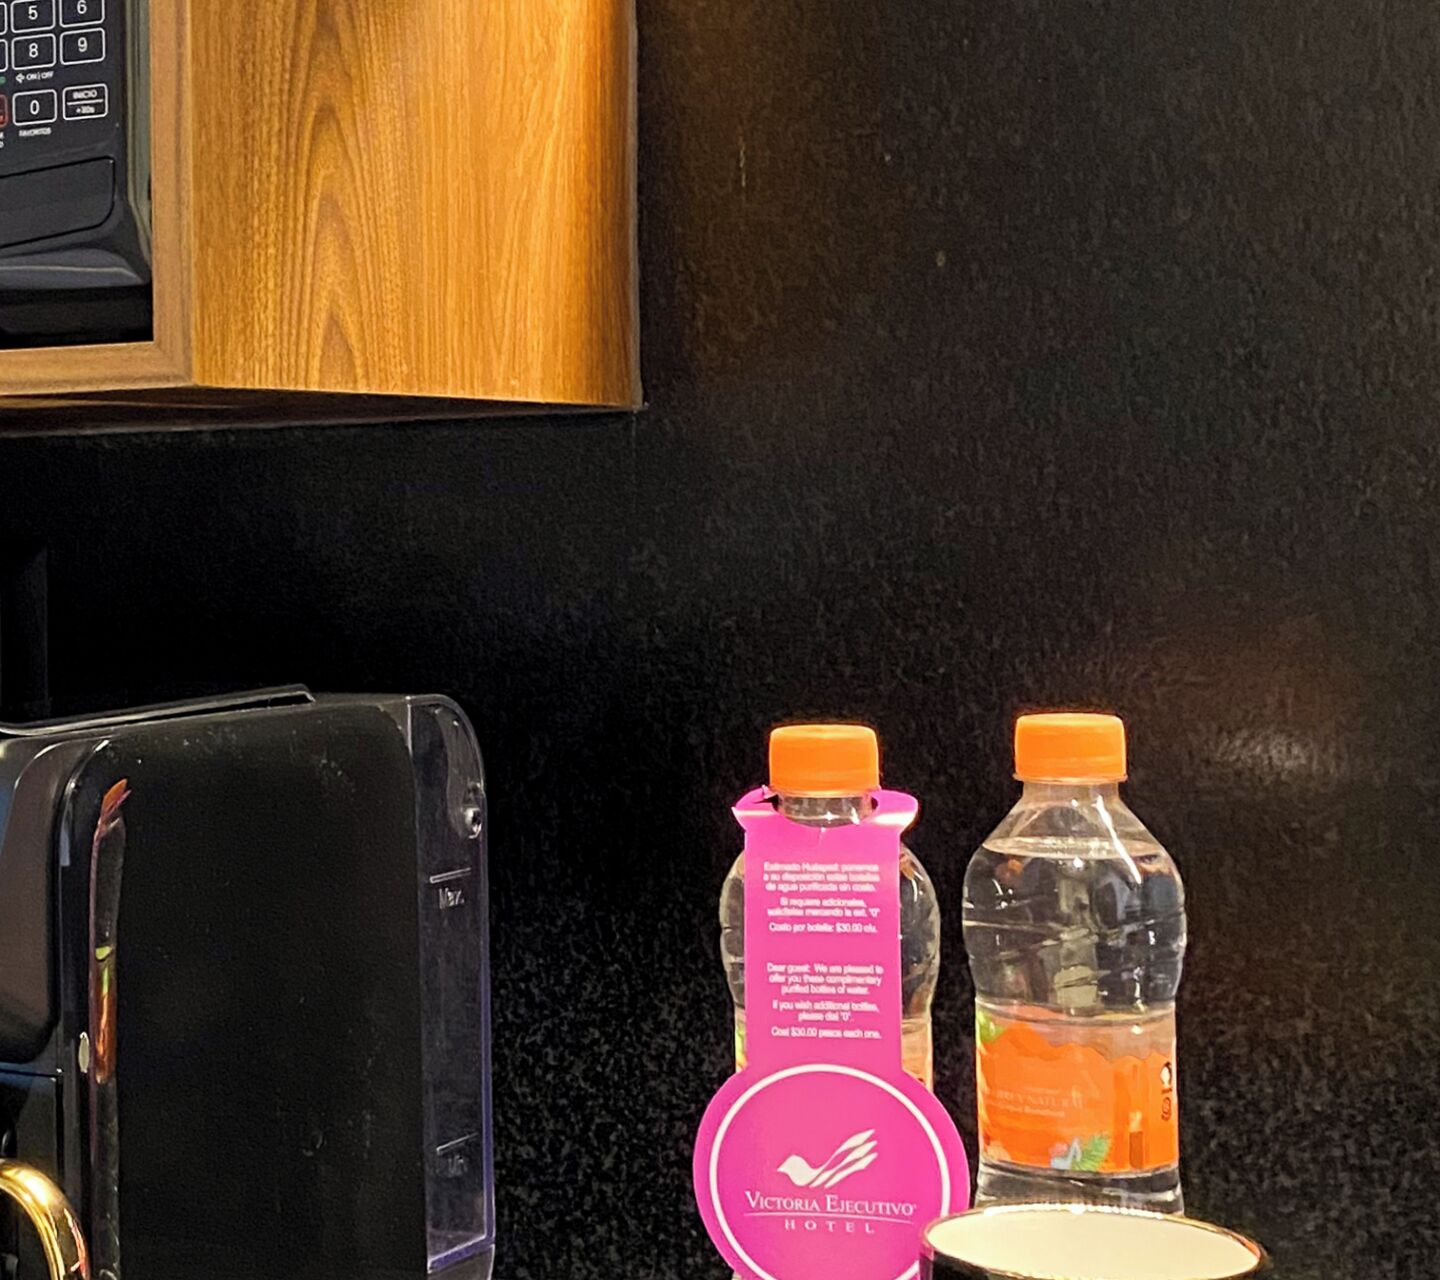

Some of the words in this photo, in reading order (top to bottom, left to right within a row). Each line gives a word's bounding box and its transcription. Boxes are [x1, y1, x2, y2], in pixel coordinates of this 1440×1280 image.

[28, 4, 39, 20] 5
[76, 0, 88, 15] 6
[28, 42, 40, 58] 8
[77, 36, 89, 53] 9
[72, 89, 98, 99] INICIO
[29, 99, 40, 115] 0
[769, 922, 792, 932] Costo
[792, 923, 806, 933] por
[767, 962, 786, 973] Dear
[813, 963, 829, 973] We
[787, 975, 802, 985] you
[779, 1002, 794, 1012] you
[771, 1026, 790, 1037] Cost
[744, 1190, 821, 1212] VICTORIA
[825, 1194, 914, 1217] EJECUTIVO
[784, 1218, 875, 1235] HOTEL
